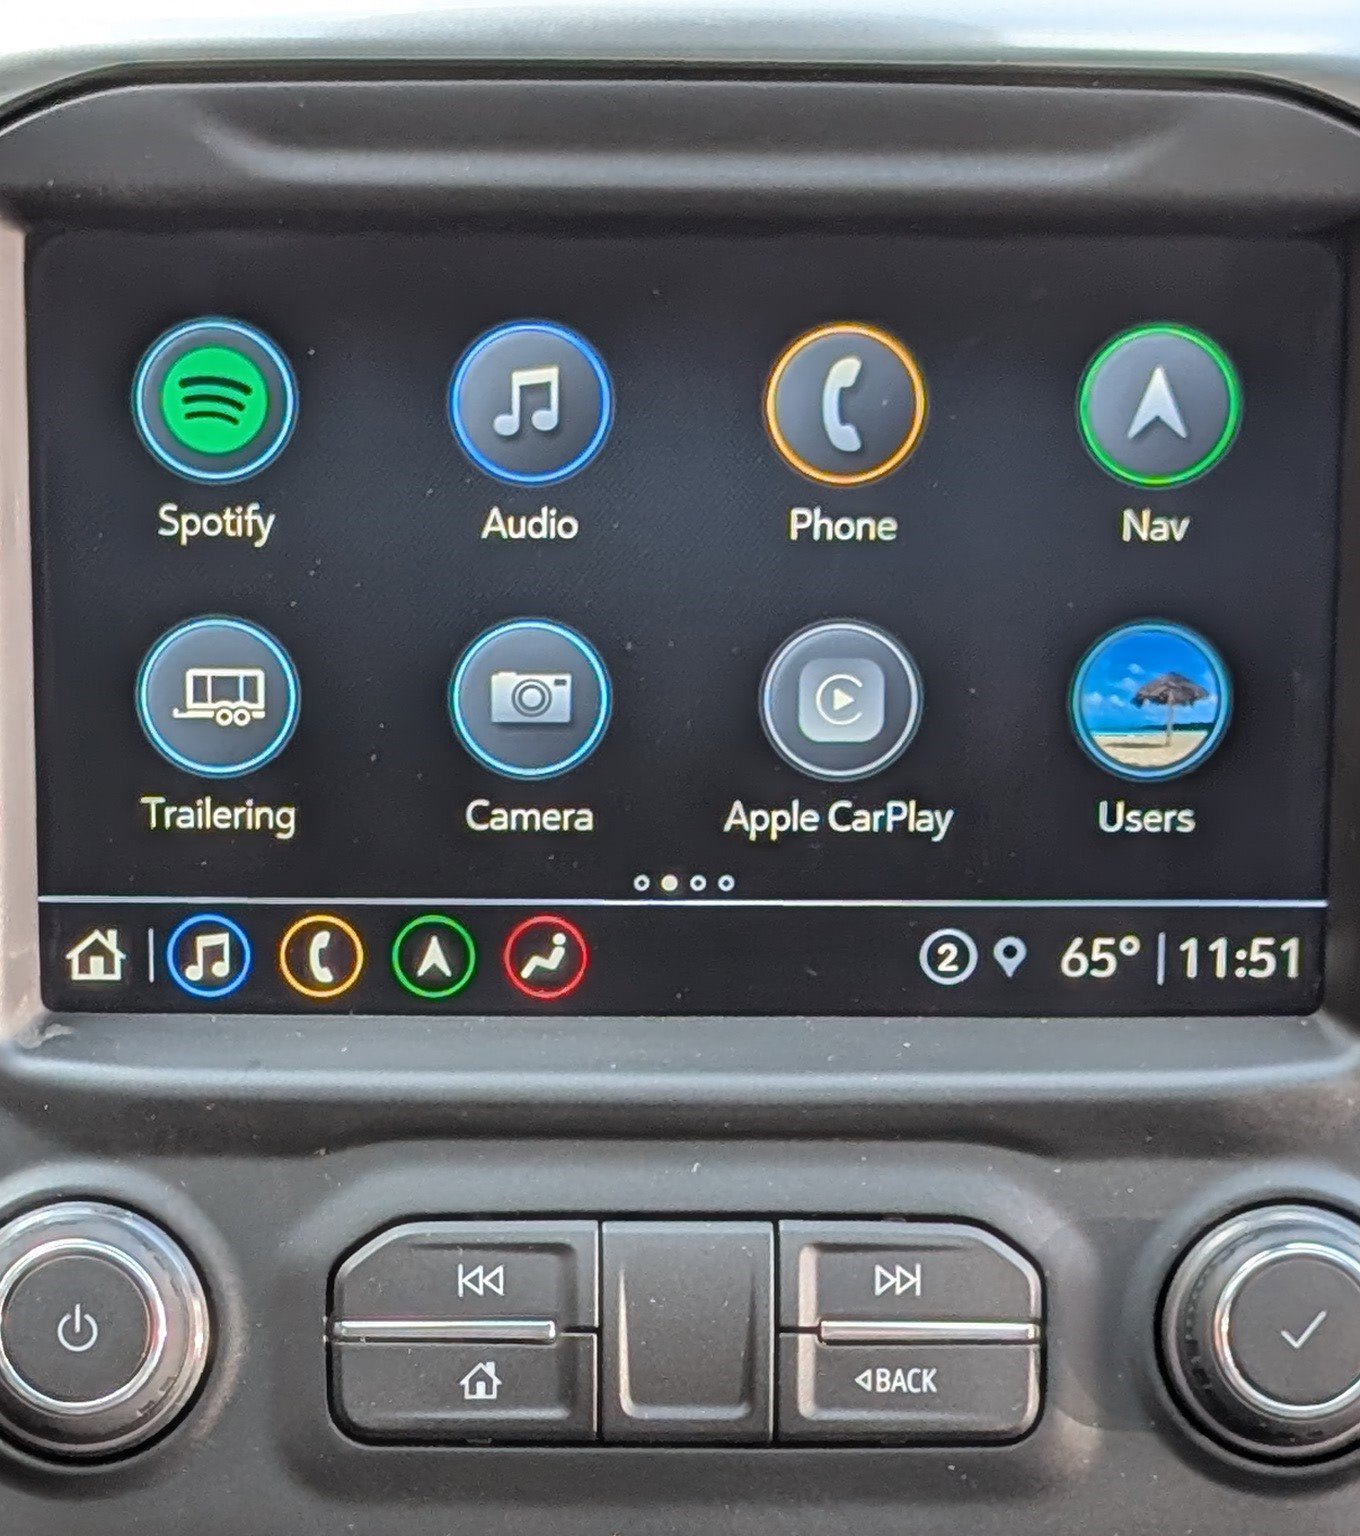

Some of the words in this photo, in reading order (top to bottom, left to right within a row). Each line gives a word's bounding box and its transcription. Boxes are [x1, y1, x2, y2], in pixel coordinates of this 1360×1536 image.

[157, 502, 276, 548] Spotify
[481, 505, 579, 540] Audio
[790, 506, 898, 541] Phone
[1122, 508, 1190, 542] Nav
[140, 795, 296, 840] Trailering
[465, 798, 594, 832] Camera
[723, 799, 820, 842] Apple
[827, 799, 955, 842] CarPlay
[1098, 800, 1196, 833] Users
[936, 944, 960, 973] 2
[1060, 935, 1141, 978] 65°
[1179, 937, 1299, 979] 11:51
[875, 1367, 938, 1394] BACK
